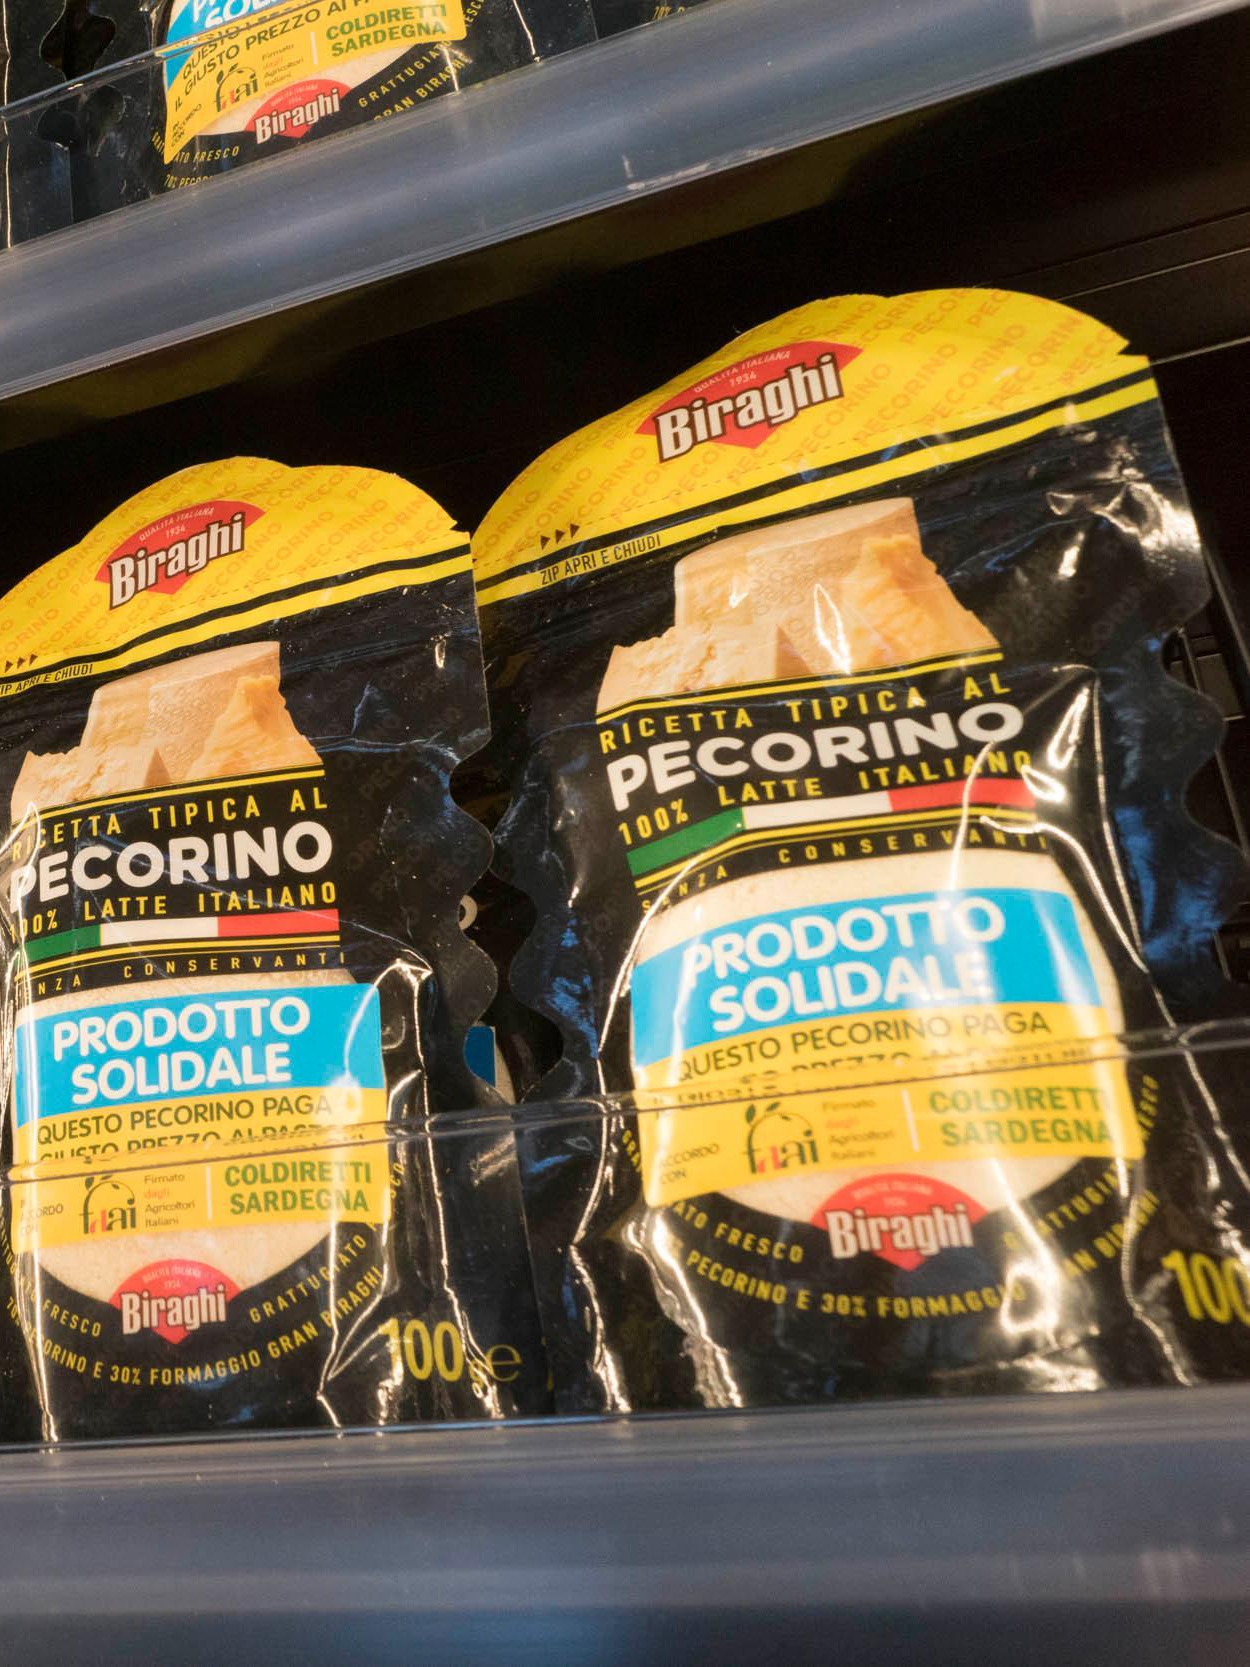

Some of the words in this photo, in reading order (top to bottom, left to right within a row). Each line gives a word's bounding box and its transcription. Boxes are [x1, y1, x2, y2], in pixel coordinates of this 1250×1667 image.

[326, 3, 447, 41] COLDIRETTI
[331, 21, 446, 57] SARDEGNA
[185, 45, 240, 96] GIUSTO
[246, 9, 320, 50] PREZZO
[254, 88, 341, 145] Biraghi
[193, 146, 240, 164] FRESCO
[654, 351, 844, 463] Biraghi
[729, 371, 758, 388] 1934
[107, 511, 245, 611] Biraghi
[540, 566, 560, 587] ZIP
[565, 554, 598, 579] APRI
[600, 549, 611, 565] E
[613, 534, 662, 561] CHIUDI
[15, 675, 40, 692] APRI
[43, 672, 51, 682] E
[53, 663, 93, 682] CHIUDI
[599, 707, 754, 755] RICETTA
[787, 687, 926, 724] TIPICA
[963, 672, 1012, 701] AL
[606, 702, 1024, 812] PECORINO
[12, 813, 121, 861] RICETTA
[149, 795, 261, 830] TIPICA
[290, 787, 328, 813] AL
[618, 798, 689, 846] 100%
[718, 778, 823, 807] LATTE
[858, 750, 1032, 790] ITALIANO
[9, 821, 333, 913] PECORINO
[9, 909, 58, 943] 100%
[84, 896, 167, 921] LATTE
[198, 882, 336, 913] ITALIANO
[124, 951, 346, 979] CONSERVANTI
[683, 896, 1007, 988] PRODOTTO
[710, 952, 1000, 1033] SOLIDALE
[53, 996, 311, 1061] PRODOTTO
[677, 1037, 782, 1082] QUESTO
[791, 1015, 952, 1054] PECORINO
[962, 1010, 1052, 1038] PAGA
[71, 1043, 292, 1104] SOLIDALE
[37, 1113, 123, 1145] QUESTO
[130, 1098, 255, 1130] PECORINO
[263, 1095, 333, 1116] PAGA
[941, 1119, 1114, 1148] SARDEGNA
[143, 1173, 186, 1186] Firmato
[225, 1161, 372, 1188] COLDIRETTI
[229, 1188, 370, 1215] SARDEGNA
[714, 1223, 804, 1264] FRESCO
[824, 1202, 975, 1260] Biraghi
[120, 1285, 228, 1335] Biraghi
[687, 1250, 787, 1305] PECORINO
[797, 1290, 812, 1311] E
[821, 1293, 867, 1317] 30%
[42, 1299, 102, 1338] FRESCO
[94, 1361, 104, 1379] E
[110, 1365, 141, 1386] 30%
[150, 1350, 262, 1385] FORMAGGIO
[267, 1322, 319, 1359] GRAN
[321, 1265, 383, 1328] BIRAGHI
